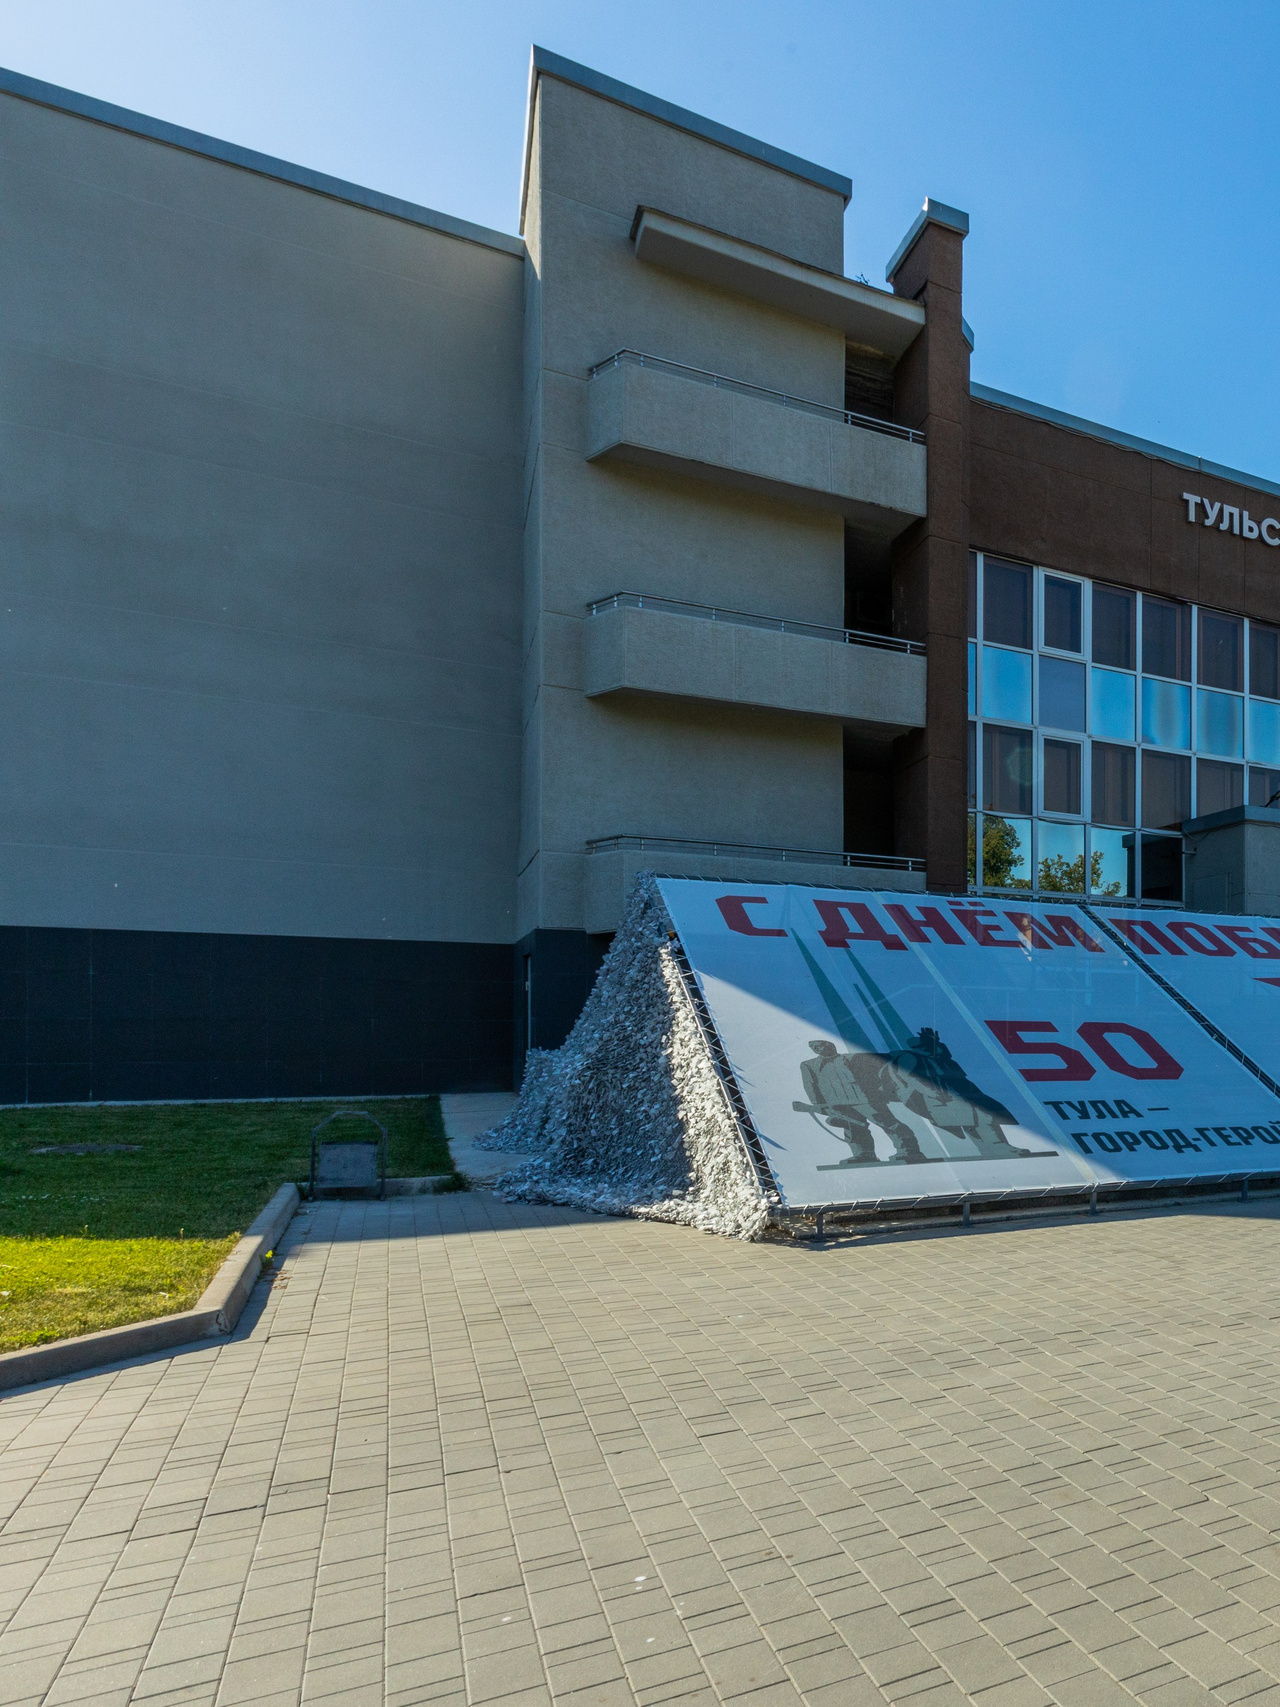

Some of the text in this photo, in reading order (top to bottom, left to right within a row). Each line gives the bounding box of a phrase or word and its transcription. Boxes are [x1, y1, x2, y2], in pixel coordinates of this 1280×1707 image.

[715, 895, 789, 938] С
[811, 899, 1107, 953] ДНЁМ
[983, 1020, 1185, 1082] 50
[1043, 1099, 1145, 1121] ТУЛА
